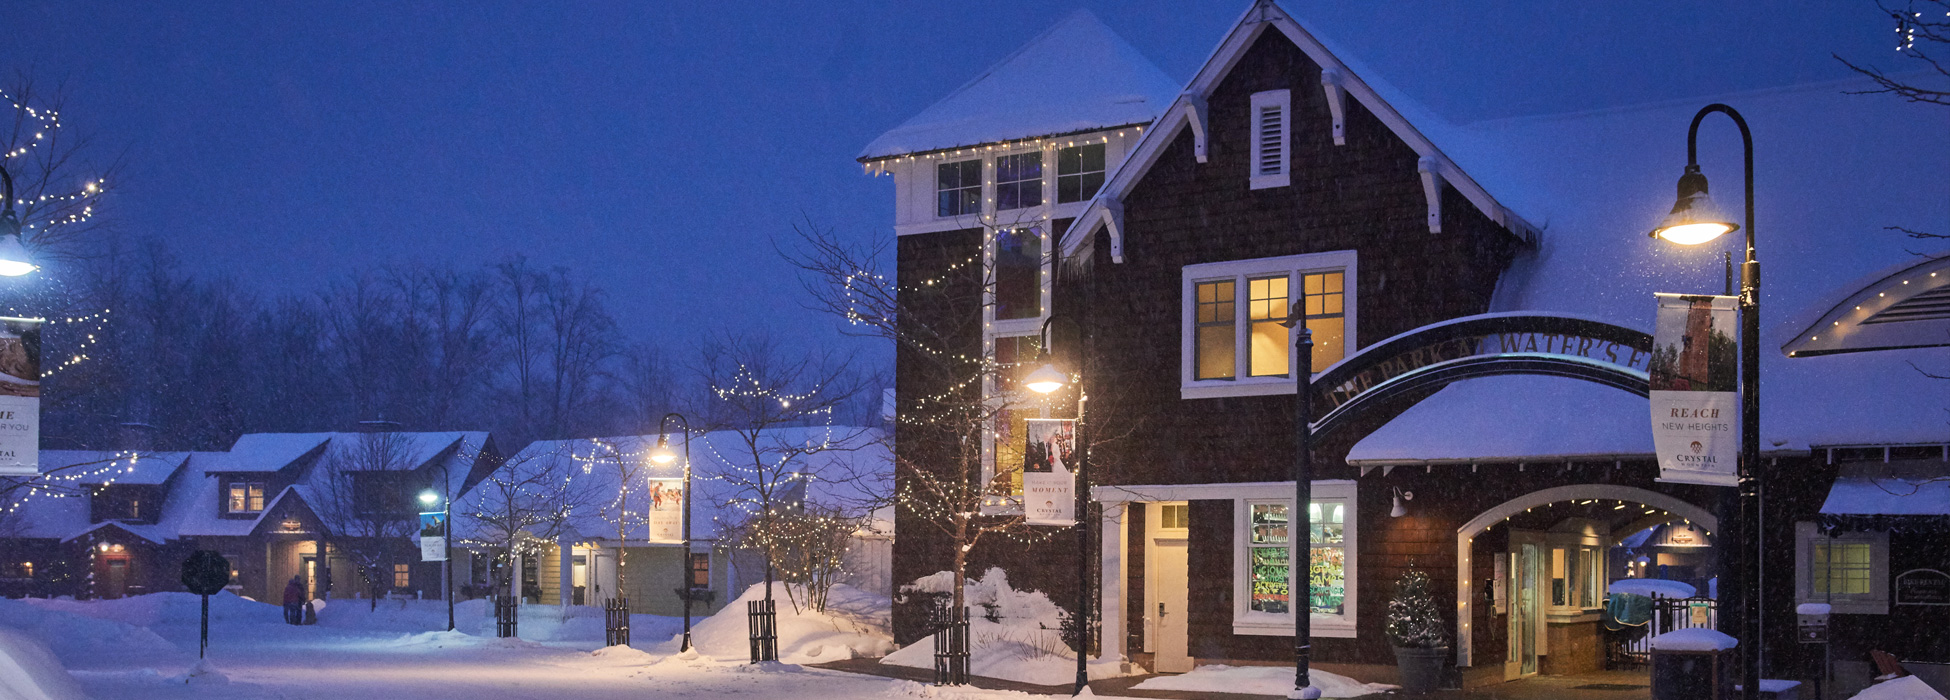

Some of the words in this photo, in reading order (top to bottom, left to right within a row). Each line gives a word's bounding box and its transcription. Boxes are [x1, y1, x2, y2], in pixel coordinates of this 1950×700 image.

[1324, 369, 1373, 408] THE
[1380, 341, 1445, 381] PARK
[1457, 334, 1490, 357] AT
[1498, 332, 1621, 364] WATER'S
[1670, 408, 1720, 418] REACH
[1662, 422, 1684, 431] NEW
[1689, 423, 1729, 432] HEIGHTS
[1676, 454, 1718, 464] CRYSTAL
